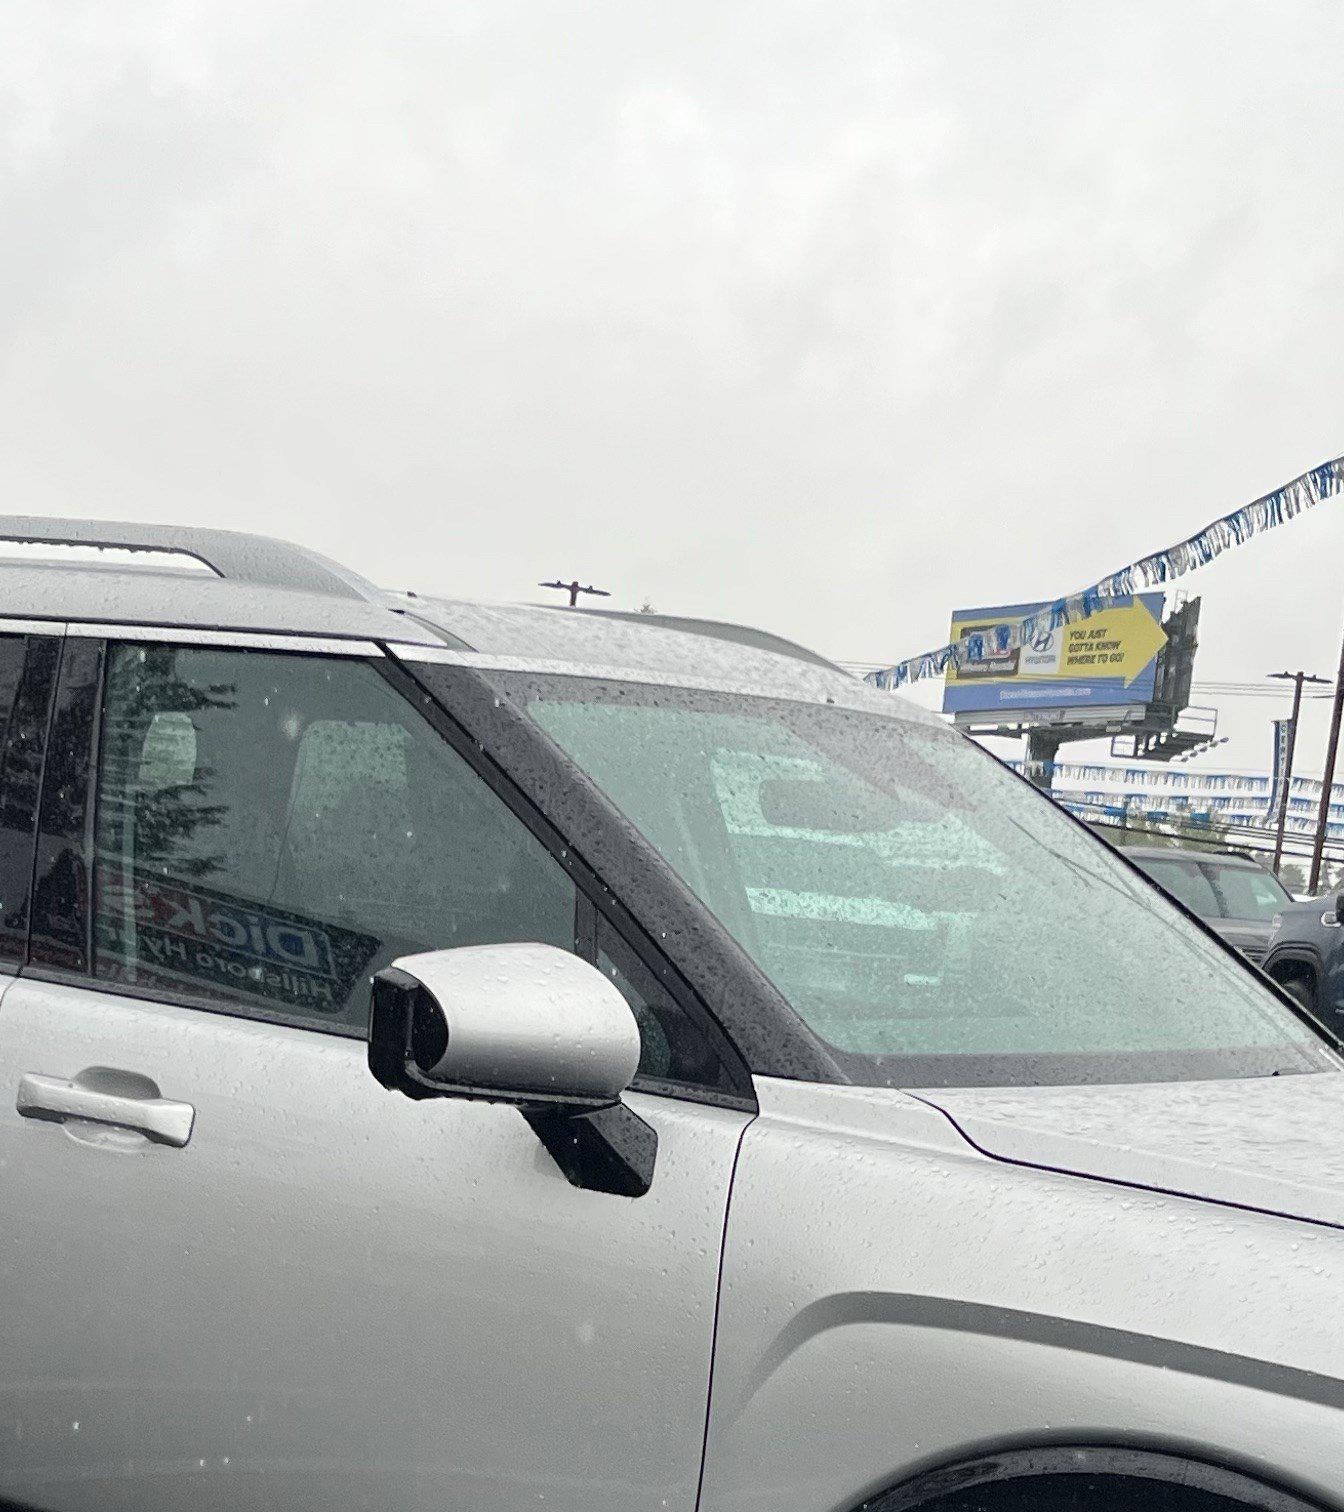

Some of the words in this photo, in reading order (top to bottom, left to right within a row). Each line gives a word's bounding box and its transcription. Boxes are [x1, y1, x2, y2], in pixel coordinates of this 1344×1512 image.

[1069, 630, 1087, 641] YOU
[1087, 628, 1108, 639] JUST
[1068, 643, 1094, 653] GOTTA
[1067, 654, 1096, 666] WHERE
[1097, 653, 1109, 664] TO
